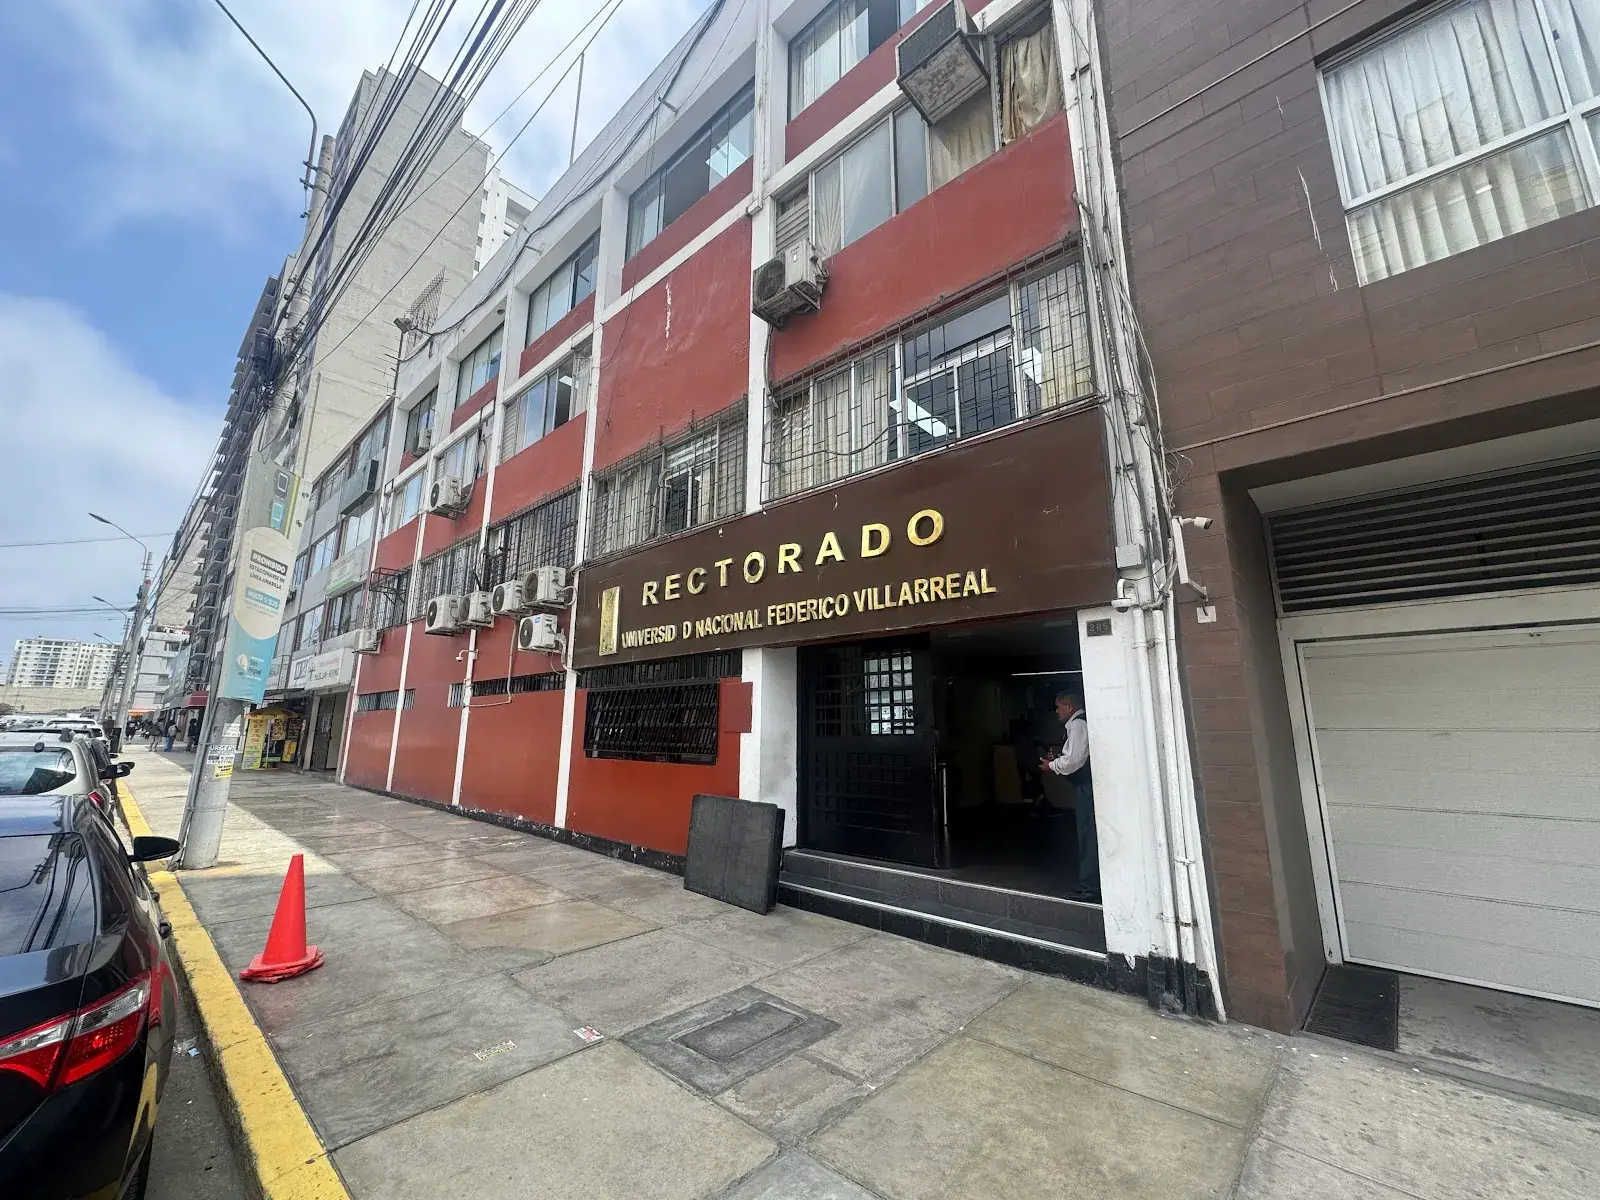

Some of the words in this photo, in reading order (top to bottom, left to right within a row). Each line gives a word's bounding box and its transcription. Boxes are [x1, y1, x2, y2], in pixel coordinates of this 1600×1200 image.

[252, 552, 286, 574] PROHIBIDO
[642, 508, 945, 606] RECTORADO
[695, 608, 763, 639] NACIONAL
[767, 593, 849, 627] FEDERICO
[853, 568, 998, 613] VILLARREAL
[1089, 622, 1109, 632] 285
